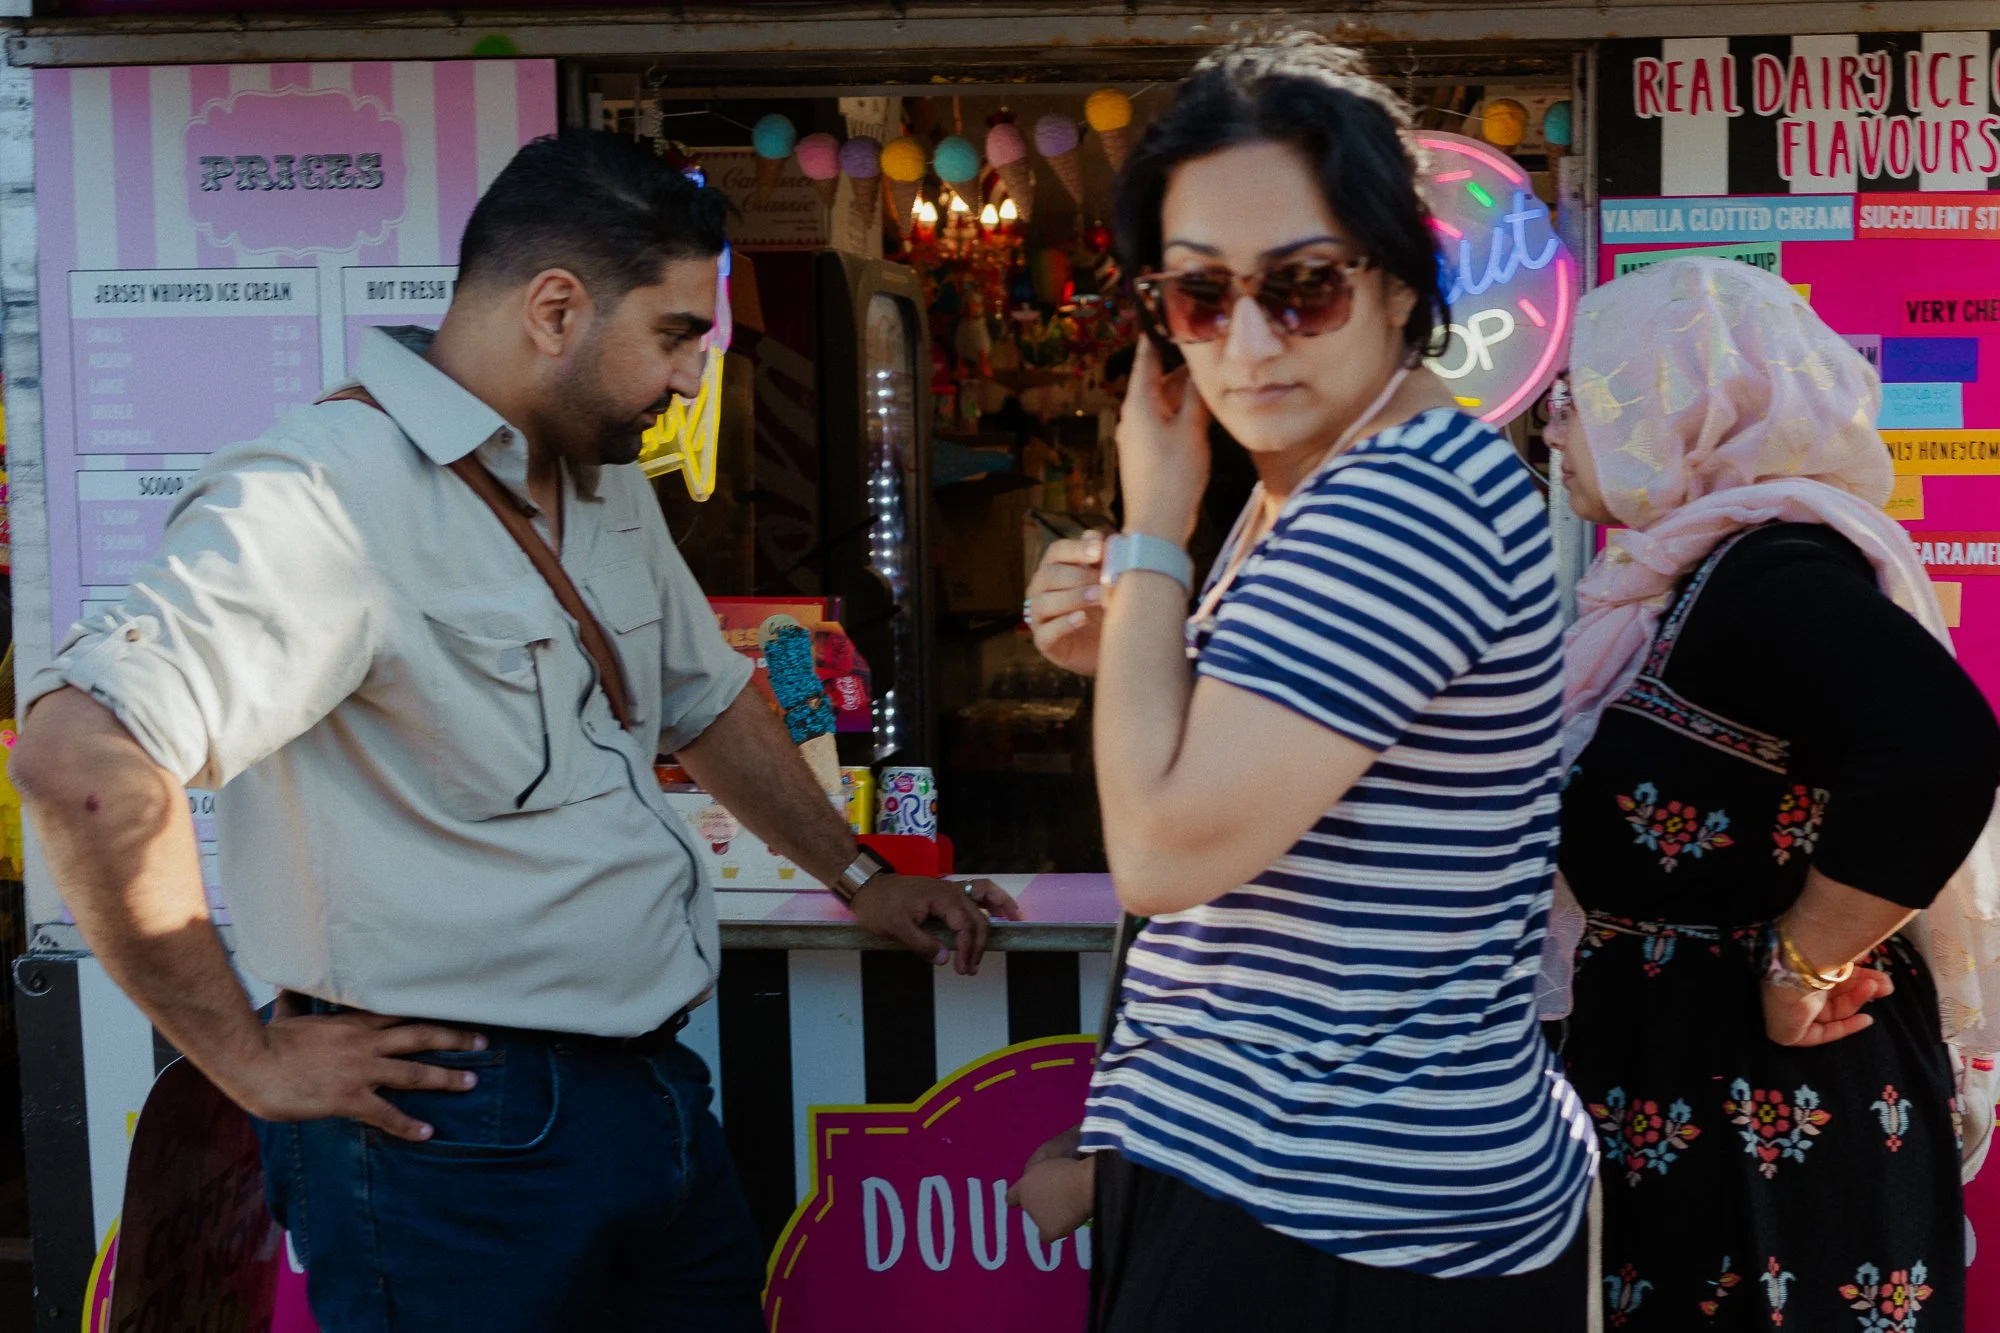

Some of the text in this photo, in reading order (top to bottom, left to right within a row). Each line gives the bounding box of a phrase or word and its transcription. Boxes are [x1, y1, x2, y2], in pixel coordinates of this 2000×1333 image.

[1635, 54, 1742, 117] REAL
[1754, 51, 1890, 115] DAIRY
[1907, 50, 1979, 110] ICE
[1779, 116, 2000, 179] FLAVOURS
[199, 152, 384, 192] PRICES
[1601, 204, 1852, 234] VANILLA CLOTTED CREAM
[1859, 205, 1974, 231] SUCCULENT
[94, 281, 293, 304] JERSEY WHIPPED ICE CREAM
[367, 280, 395, 300] HOT
[399, 279, 447, 300] FRESH
[1906, 299, 1959, 324] VERY
[138, 476, 185, 496] SCOOP
